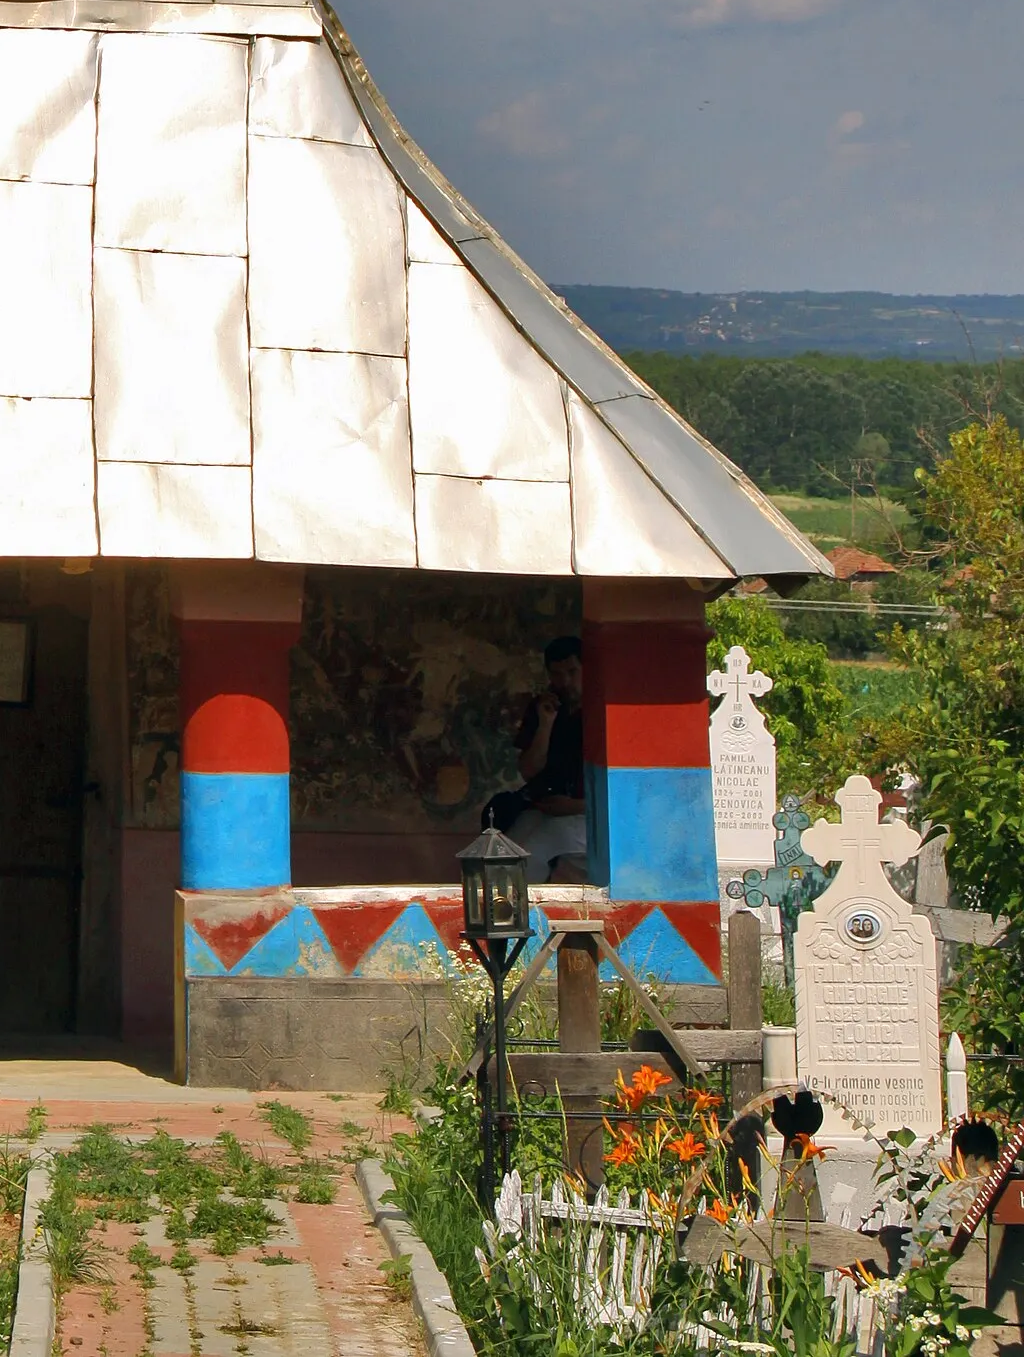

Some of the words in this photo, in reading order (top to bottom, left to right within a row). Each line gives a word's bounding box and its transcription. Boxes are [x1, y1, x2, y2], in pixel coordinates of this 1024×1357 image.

[719, 754, 756, 763] FAMILIA
[716, 776, 759, 787] NICOLAE
[713, 798, 764, 810] ZENOVICA
[823, 985, 909, 1005] GHEORGHE
[832, 1023, 903, 1044] FLORICA
